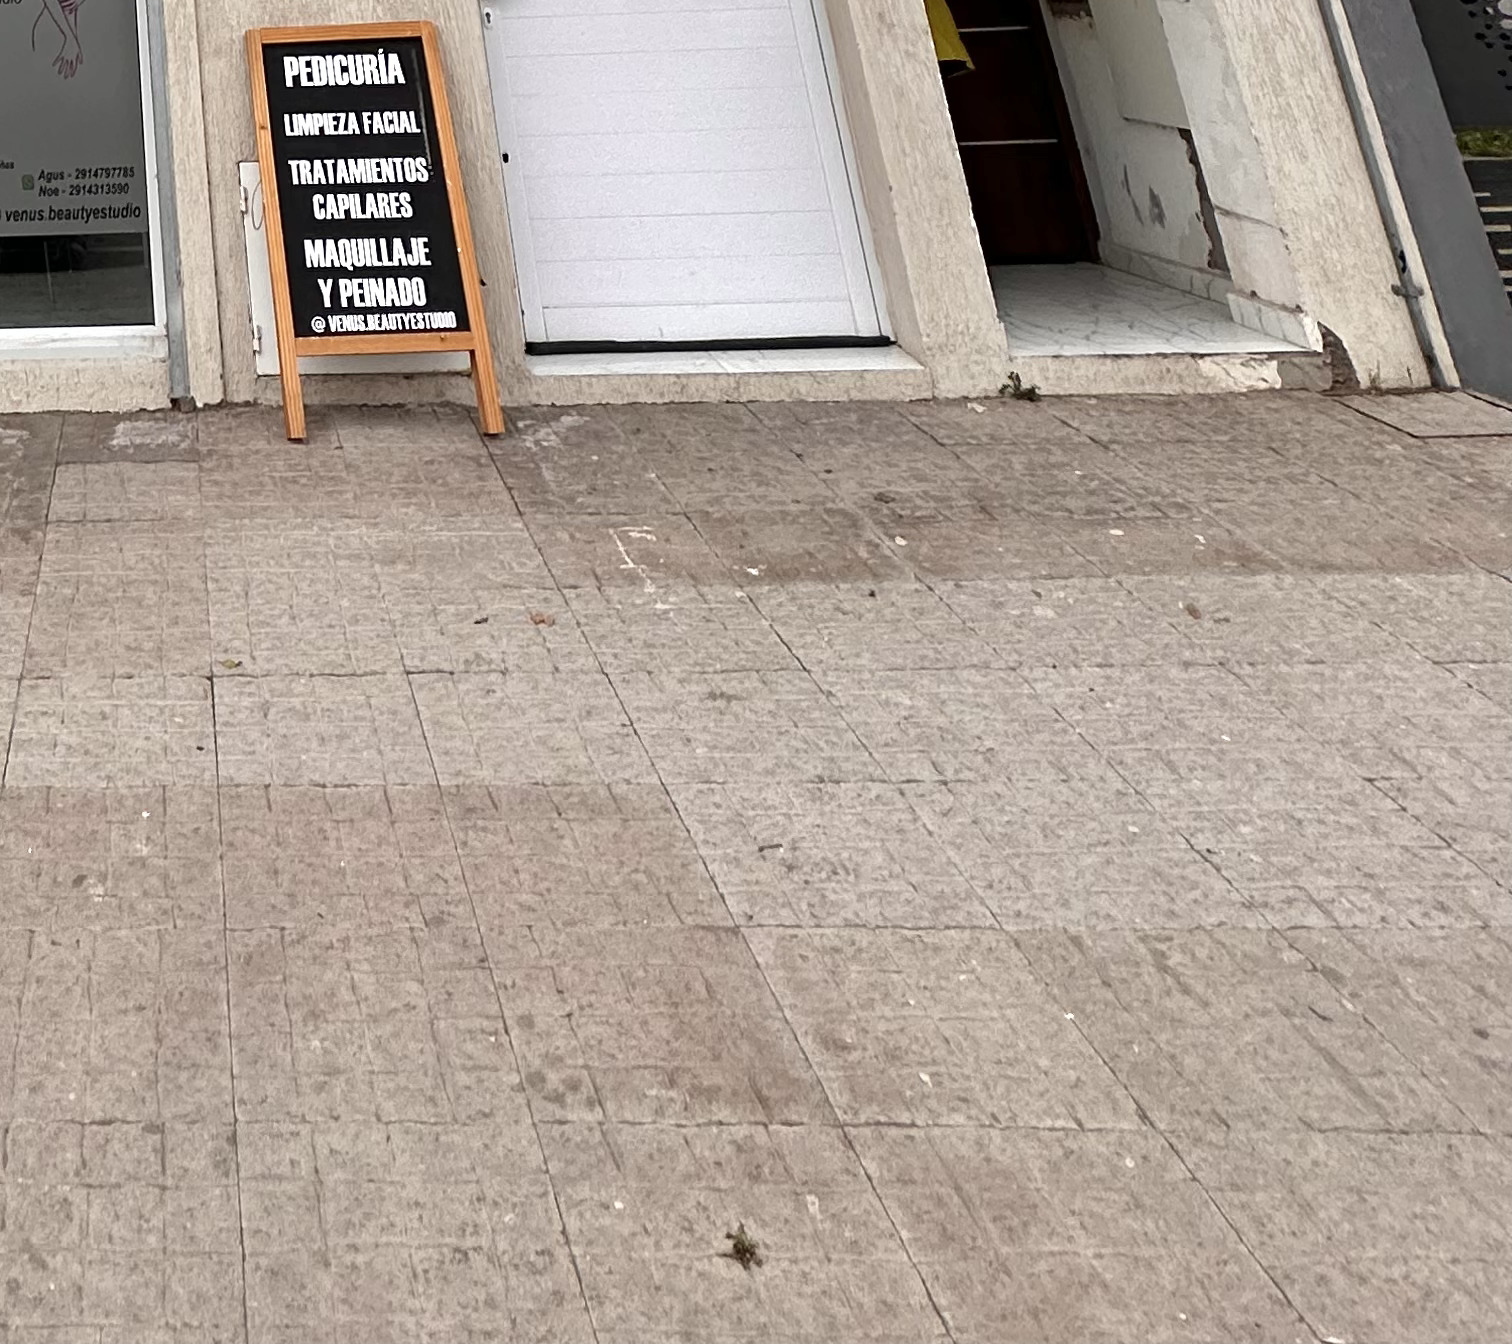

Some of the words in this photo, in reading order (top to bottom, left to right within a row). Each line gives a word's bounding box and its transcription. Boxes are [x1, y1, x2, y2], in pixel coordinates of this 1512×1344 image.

[283, 48, 406, 87] PEDICURÍA
[283, 112, 360, 136] LIMPIEZA
[361, 111, 421, 134] FACIAL
[38, 169, 65, 183] Agus
[74, 166, 135, 180] 2914797785
[287, 157, 429, 185] TRATAMIENTOS
[38, 185, 60, 197] Noe
[68, 182, 130, 196] 2914313590
[312, 192, 413, 220] CAPILARES
[303, 237, 432, 271] MAQUILLAJE
[317, 278, 333, 308] Y
[338, 277, 427, 308] PEINADO
[311, 316, 326, 332] @
[328, 311, 457, 332] VENUS.BEAUTYESTUDIO
